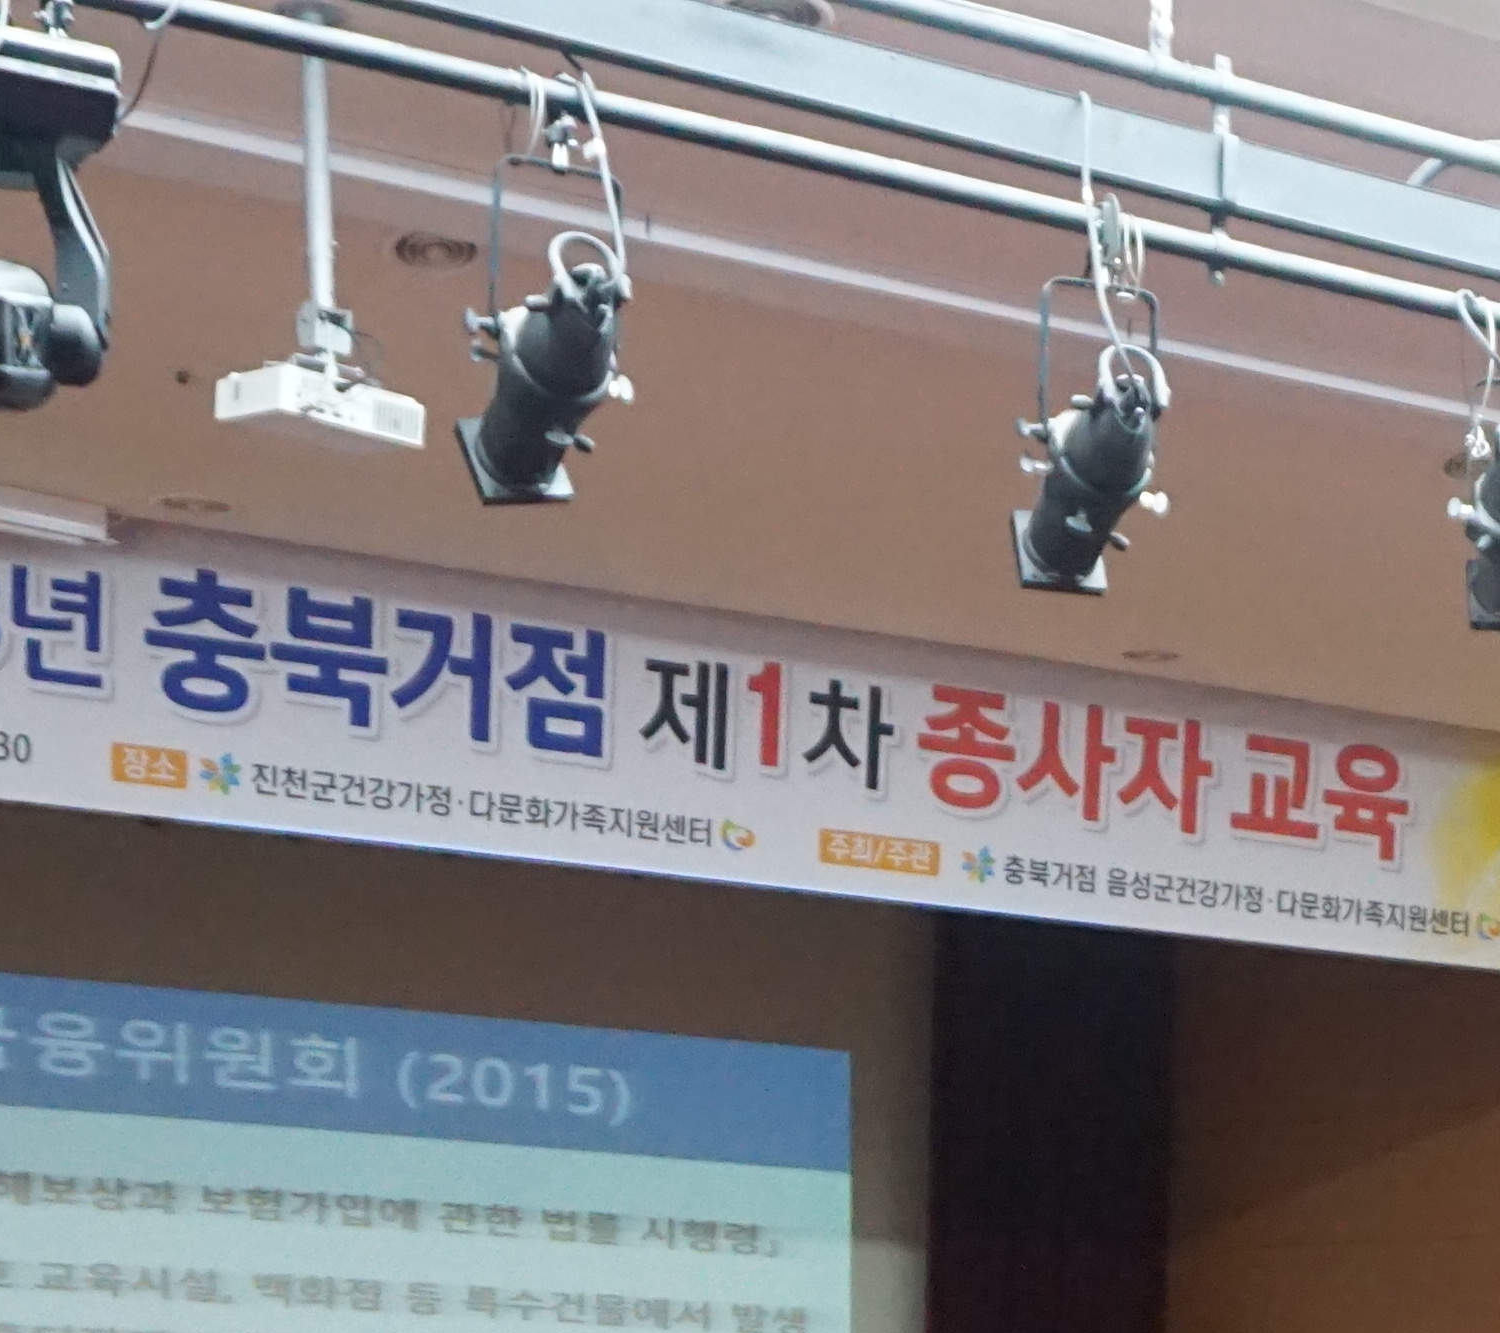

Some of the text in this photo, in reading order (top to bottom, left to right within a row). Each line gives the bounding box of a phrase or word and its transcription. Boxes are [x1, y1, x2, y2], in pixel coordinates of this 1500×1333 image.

[143, 568, 606, 759] 충북거점
[640, 657, 895, 791] 제1차
[916, 682, 1214, 837] 종사자
[1229, 731, 1412, 863] 교육
[120, 747, 179, 783] 장소
[1003, 854, 1097, 894] 충북거점
[396, 1049, 634, 1128] (2015)
[438, 1200, 522, 1240] 관한
